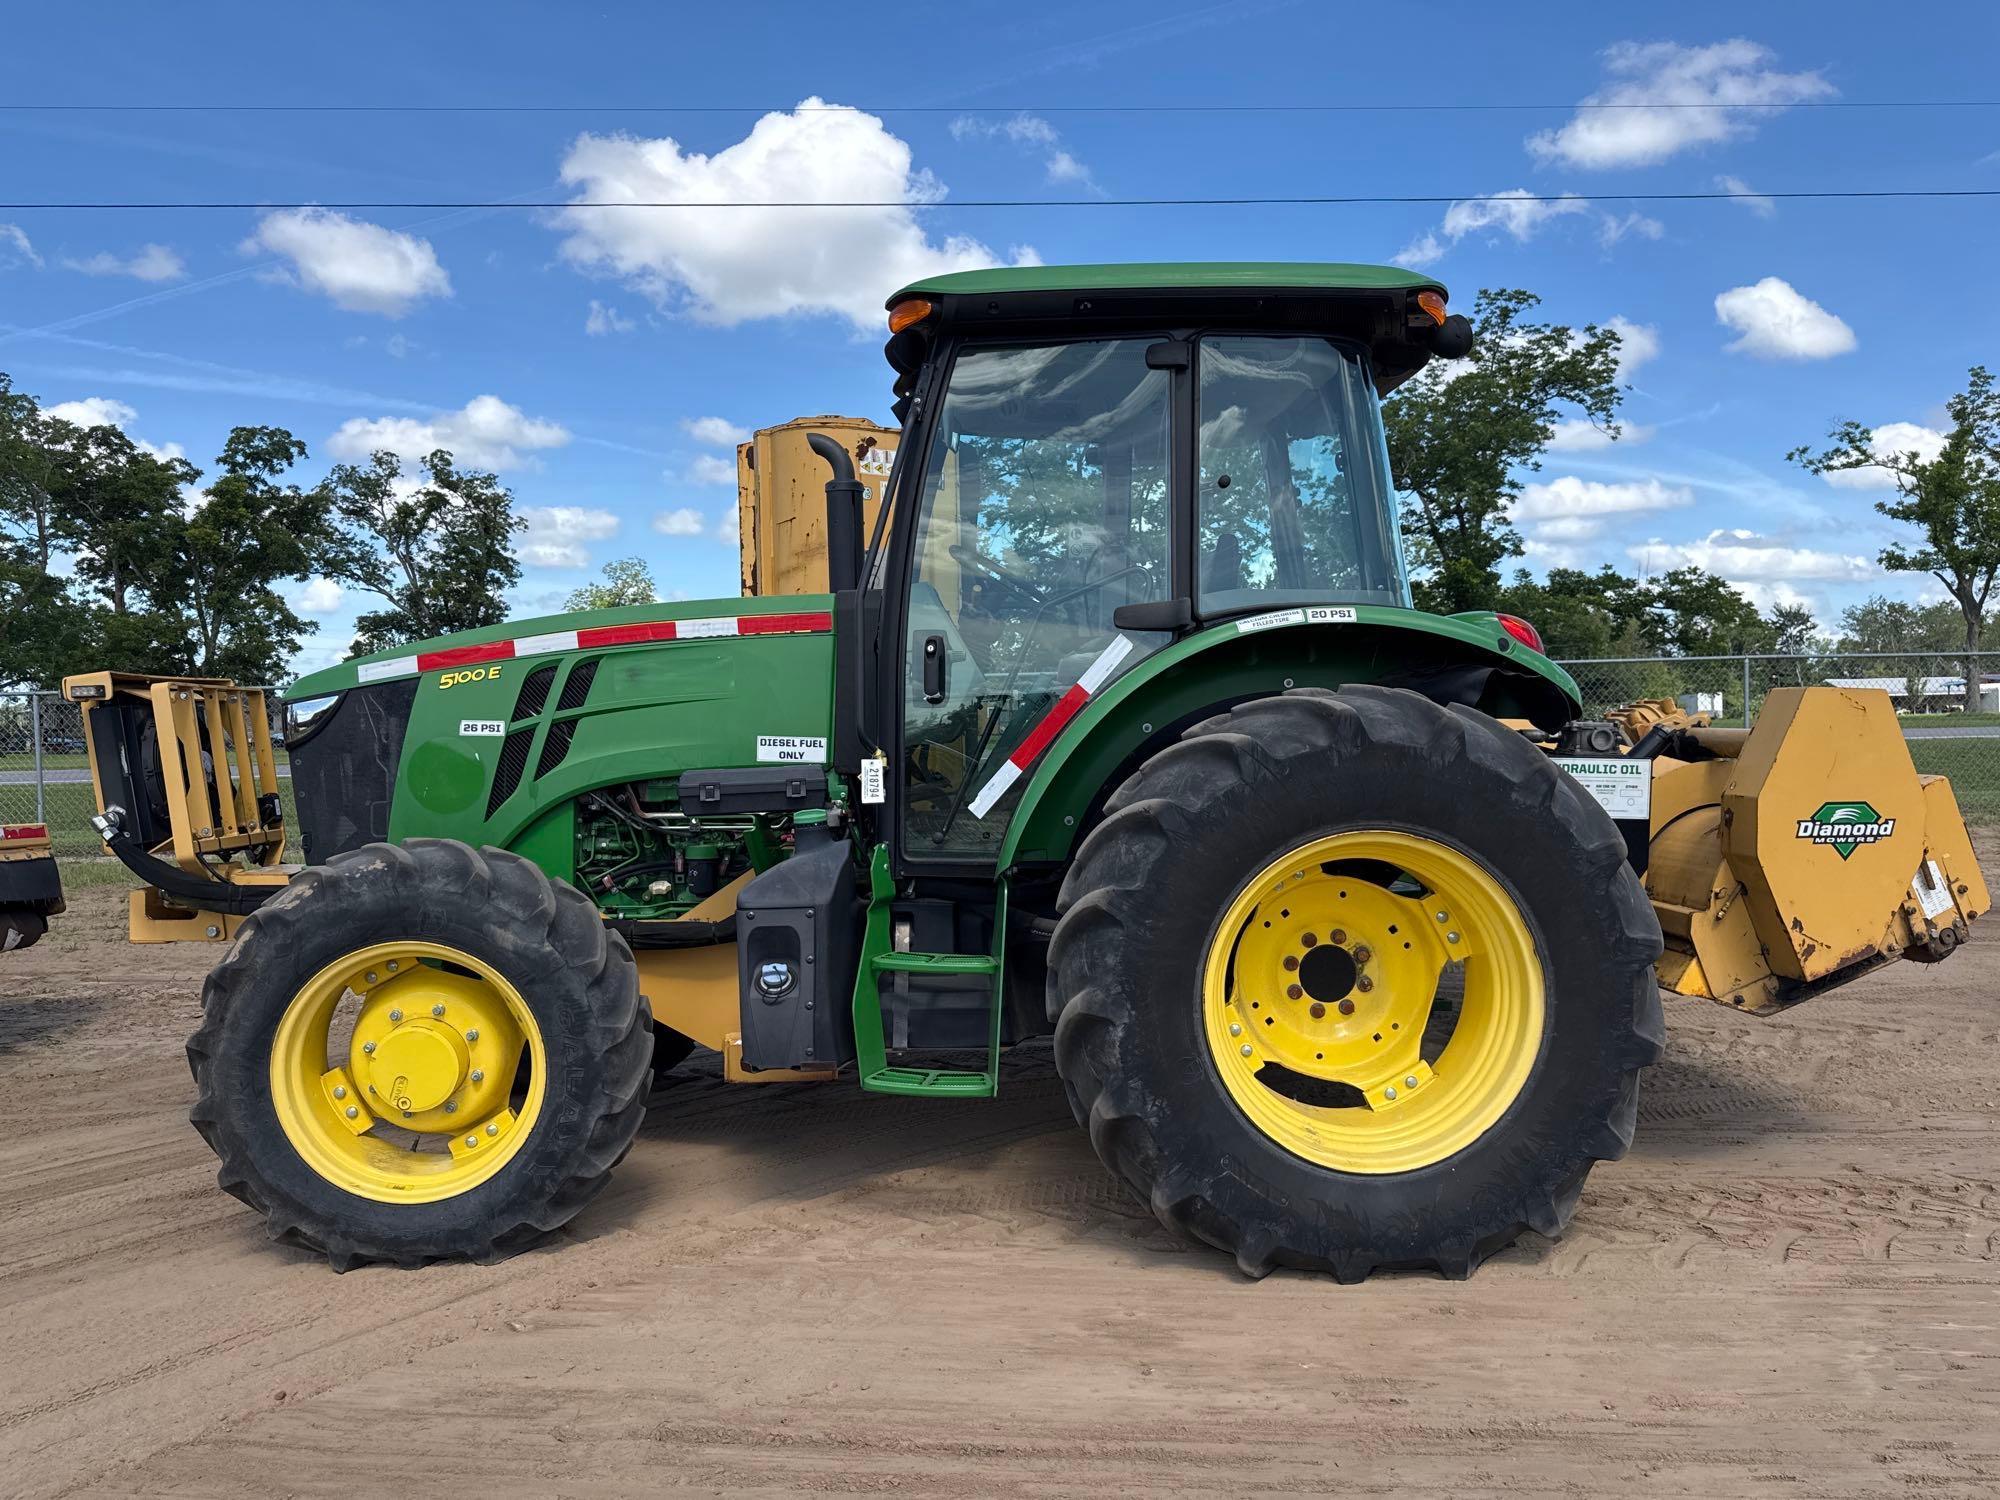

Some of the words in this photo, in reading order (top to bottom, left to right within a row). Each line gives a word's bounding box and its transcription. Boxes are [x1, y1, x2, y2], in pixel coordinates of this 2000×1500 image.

[1311, 610, 1327, 618] 20
[1331, 610, 1352, 618] PSI
[1252, 619, 1274, 628] FILLED
[439, 669, 486, 689] 5100
[488, 666, 502, 679] E
[463, 724, 478, 732] 26
[481, 724, 501, 732] PSI
[760, 738, 797, 747] DIESEL
[800, 739, 824, 748] FUEL
[779, 751, 805, 760] ONLY
[1558, 763, 1617, 775] DRAULIC
[1620, 764, 1642, 775] OIL
[869, 768, 880, 798] 218794
[1798, 820, 1894, 837] Diamond
